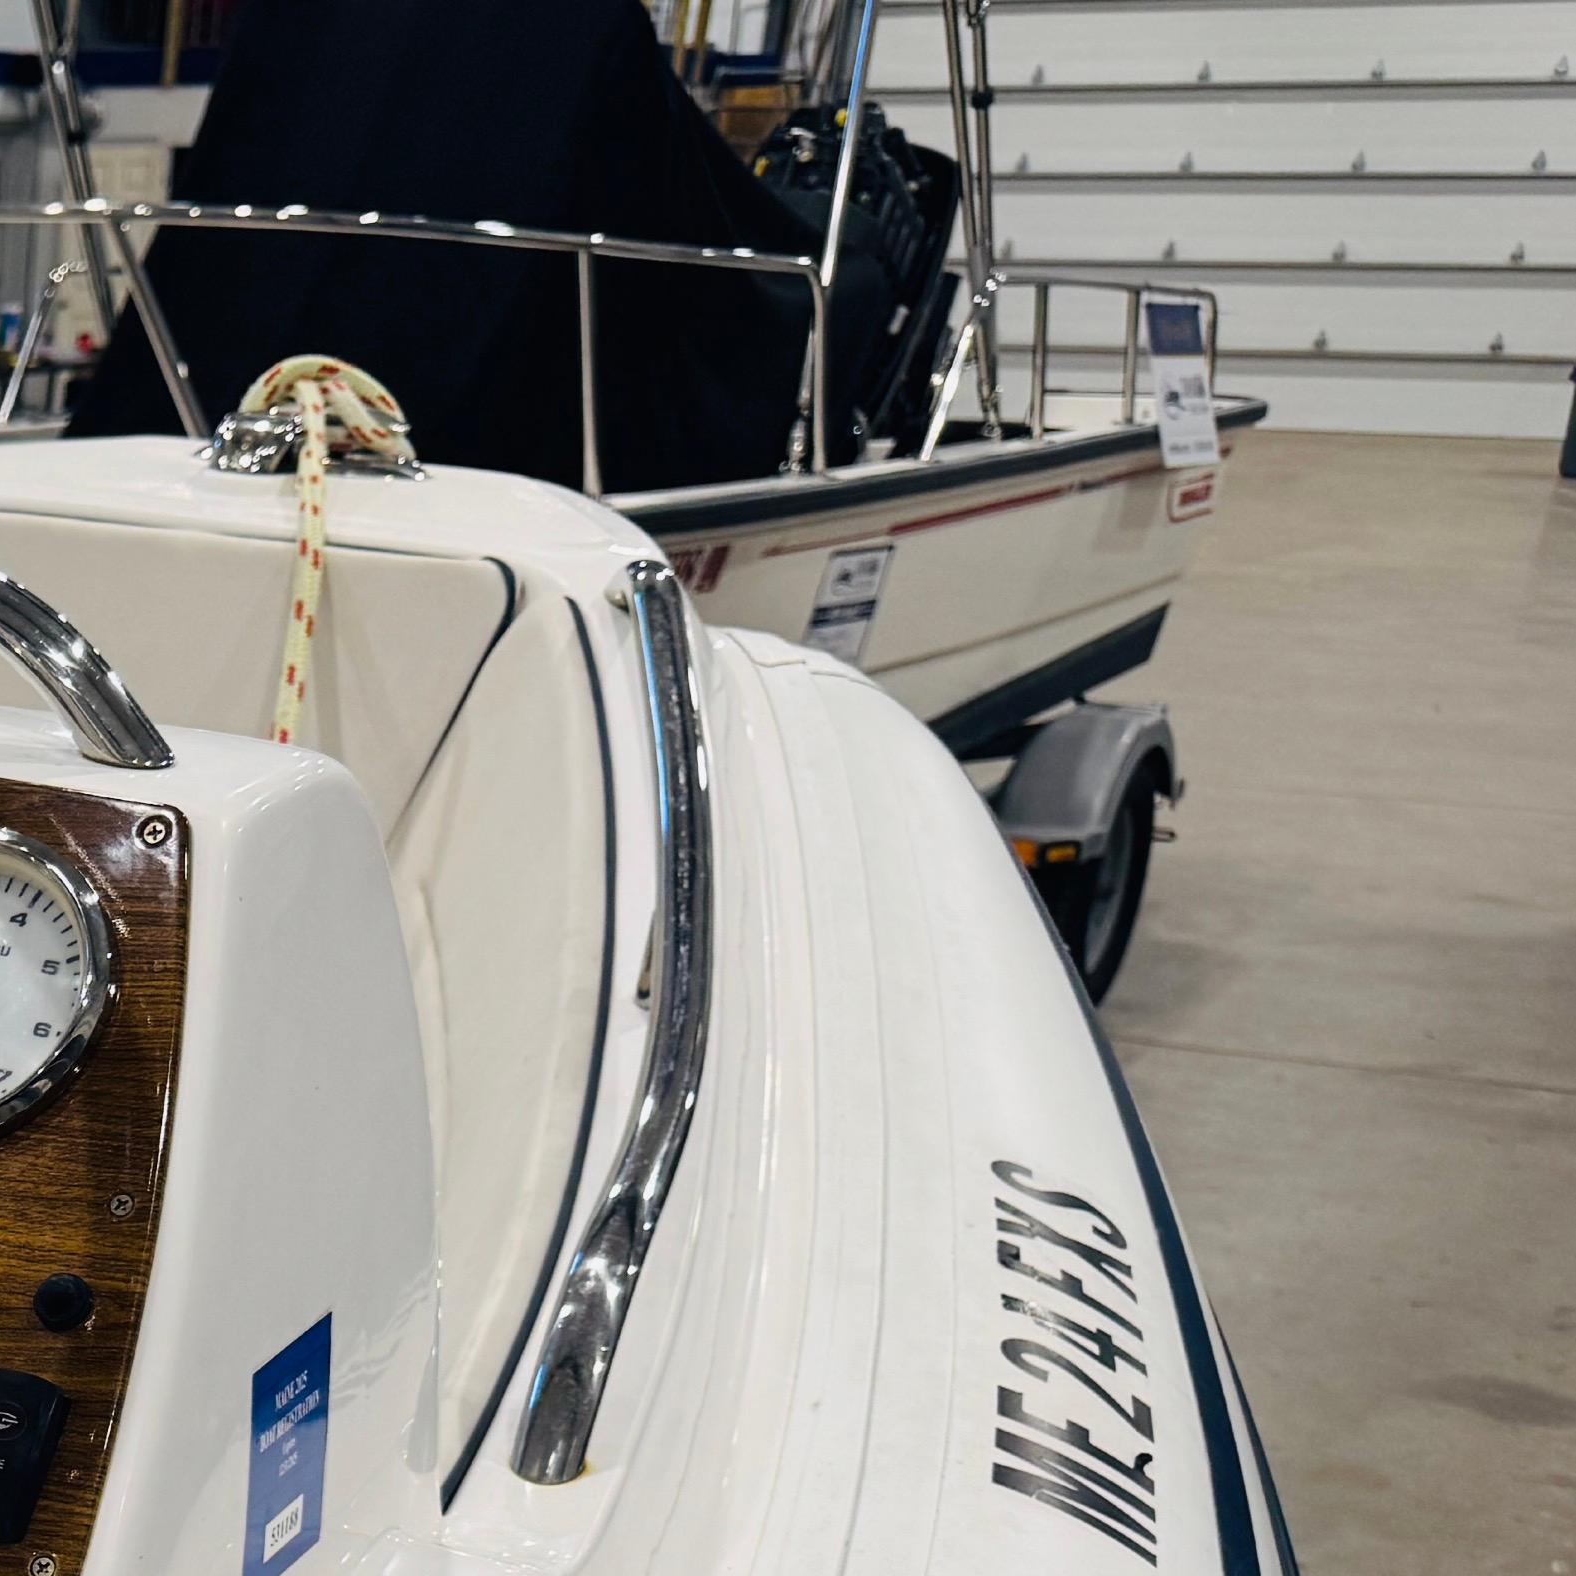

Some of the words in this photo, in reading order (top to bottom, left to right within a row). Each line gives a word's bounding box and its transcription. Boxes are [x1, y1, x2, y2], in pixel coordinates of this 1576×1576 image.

[9, 912, 28, 927] 4
[41, 959, 60, 975] 5
[33, 1022, 53, 1038] 6
